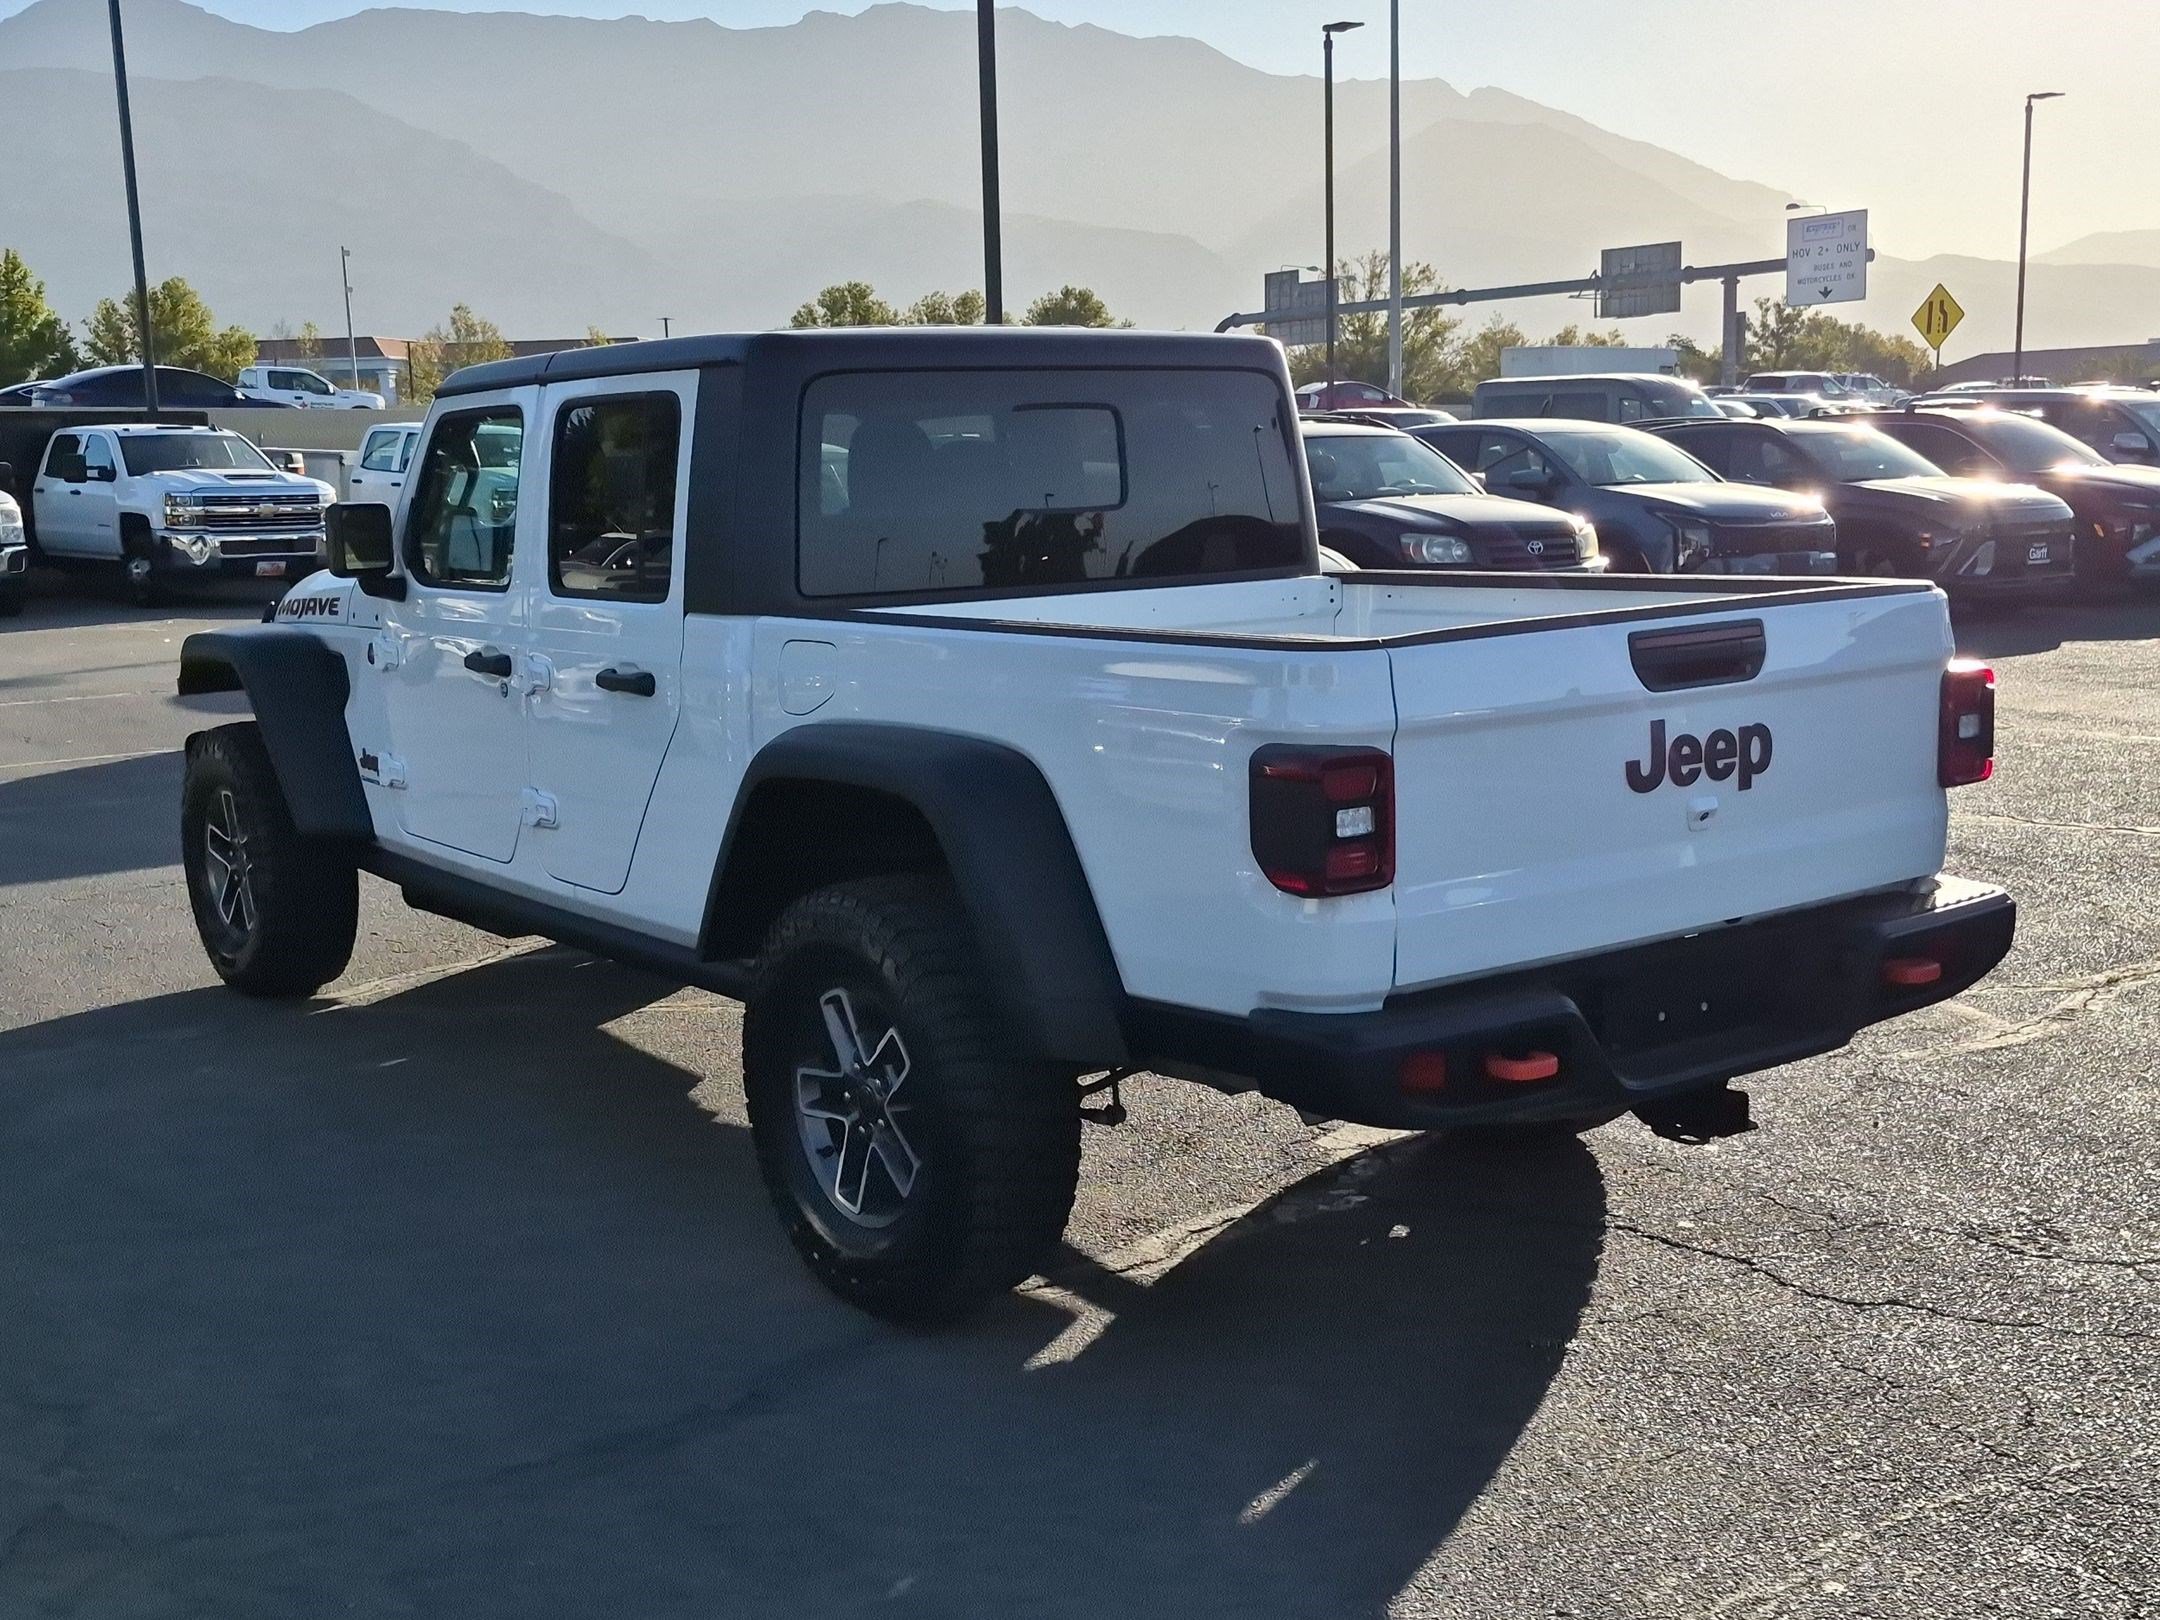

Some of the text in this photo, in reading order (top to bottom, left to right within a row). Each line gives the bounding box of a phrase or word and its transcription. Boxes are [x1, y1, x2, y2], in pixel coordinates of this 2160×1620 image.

[1792, 248, 1811, 259] HOV
[1836, 242, 1860, 254] ONLY
[1814, 261, 1853, 271] BUSES AND
[1797, 274, 1842, 285] MOTORCYCLES
[278, 597, 340, 619] MOJAVE
[1625, 719, 1773, 794] Jeep
